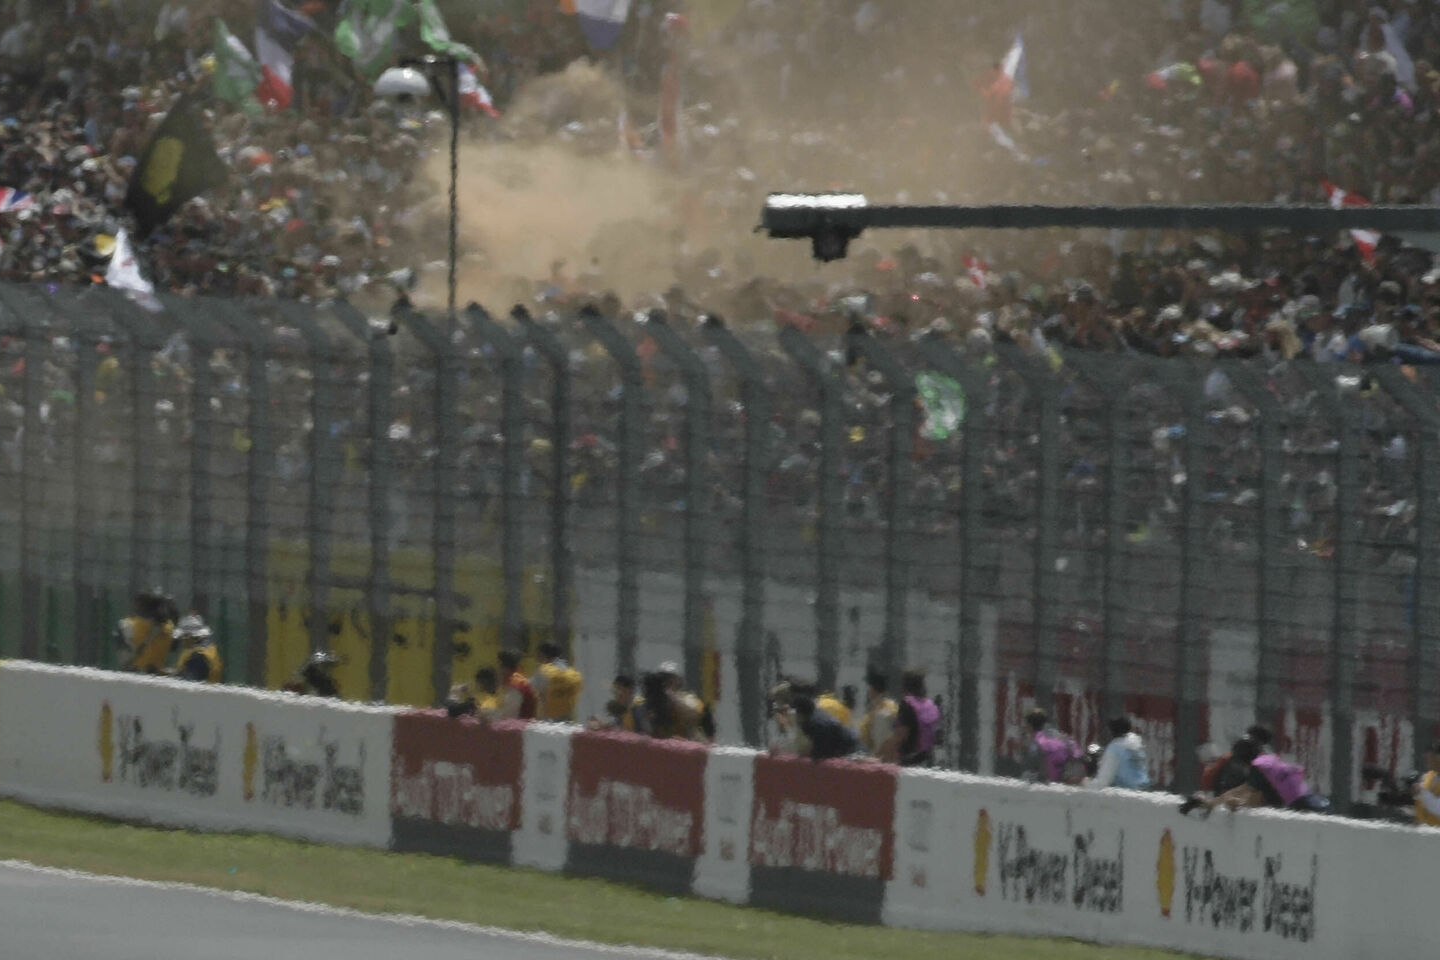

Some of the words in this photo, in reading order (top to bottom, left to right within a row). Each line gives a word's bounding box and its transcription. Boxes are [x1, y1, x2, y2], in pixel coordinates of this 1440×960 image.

[998, 822, 1068, 902] V-Power
[1072, 828, 1125, 913] Diesel
[1183, 846, 1259, 932] V-Power
[1264, 853, 1320, 942] Diesel
